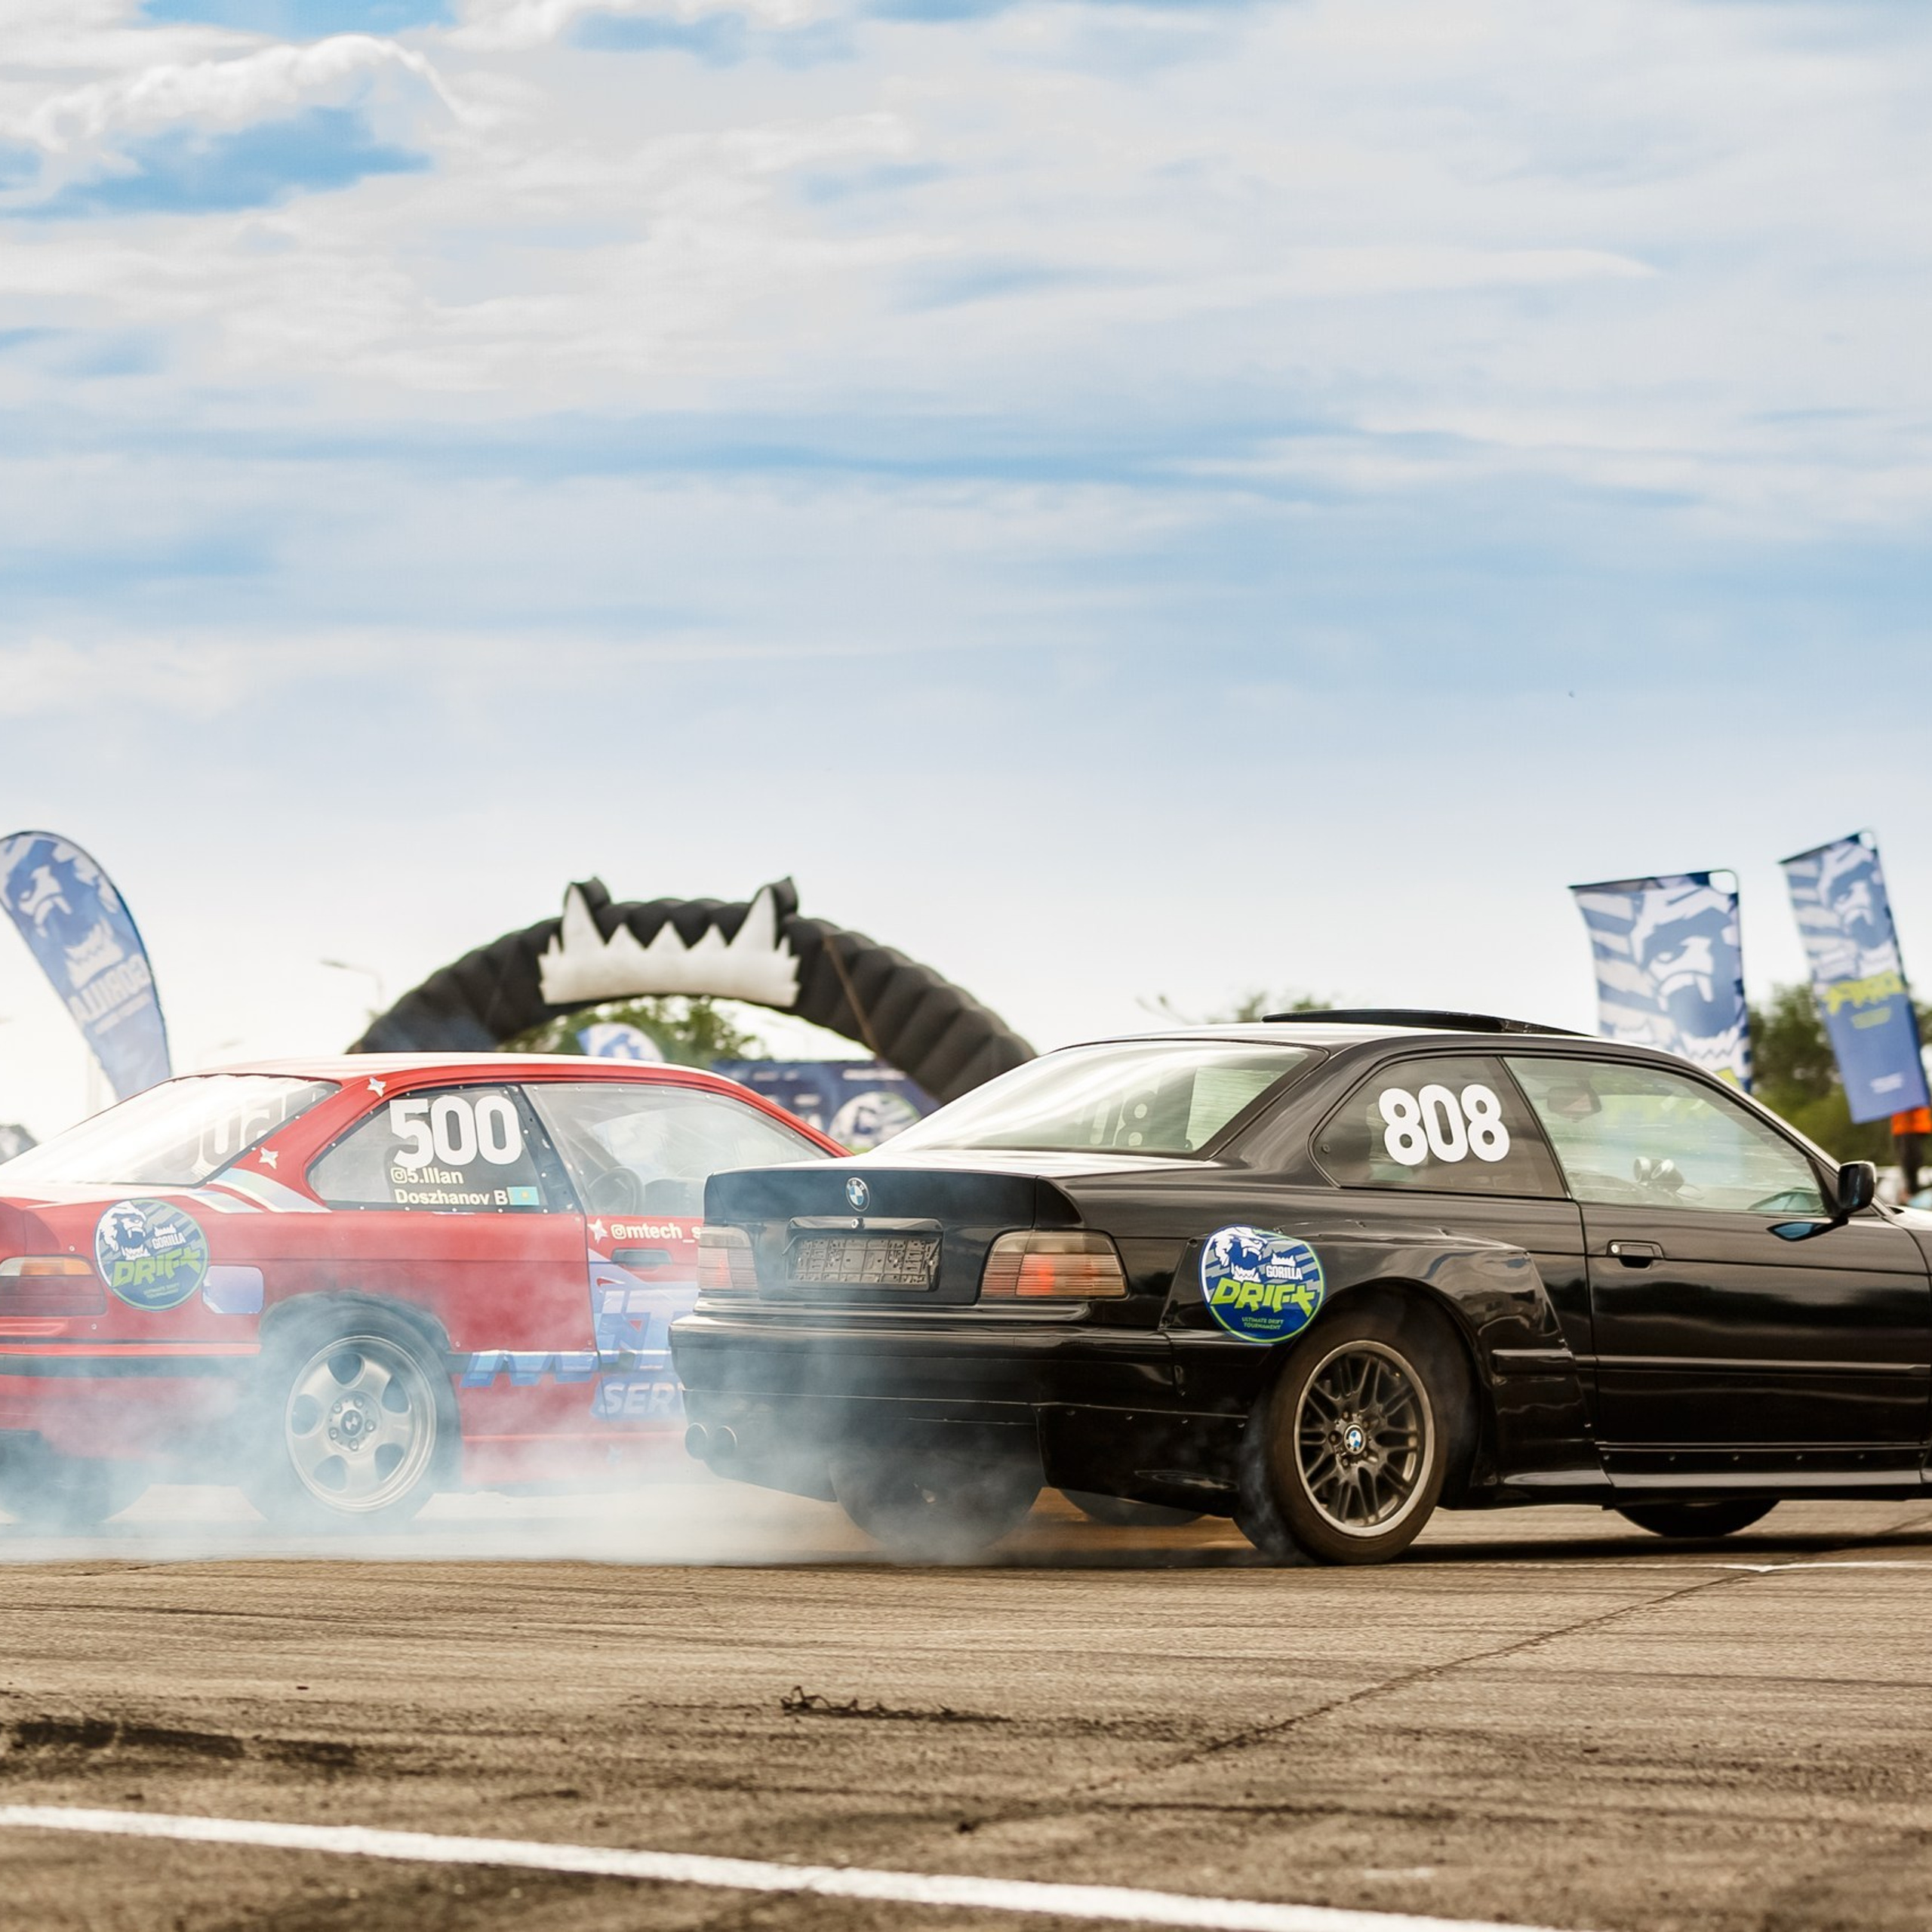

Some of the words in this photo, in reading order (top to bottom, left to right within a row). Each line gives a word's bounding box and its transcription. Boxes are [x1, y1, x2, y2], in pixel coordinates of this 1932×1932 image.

[389, 1096, 522, 1169] 500
[1379, 1084, 1510, 1165] 808
[394, 1189, 489, 1204] Doszhanov
[494, 1189, 508, 1205] B
[152, 1232, 186, 1250] GORILLA
[112, 1247, 202, 1287] DRIFT
[1266, 1265, 1303, 1281] GORILLA
[1210, 1277, 1315, 1318] DRIFT
[1244, 1321, 1281, 1330] TOURNAMENT
